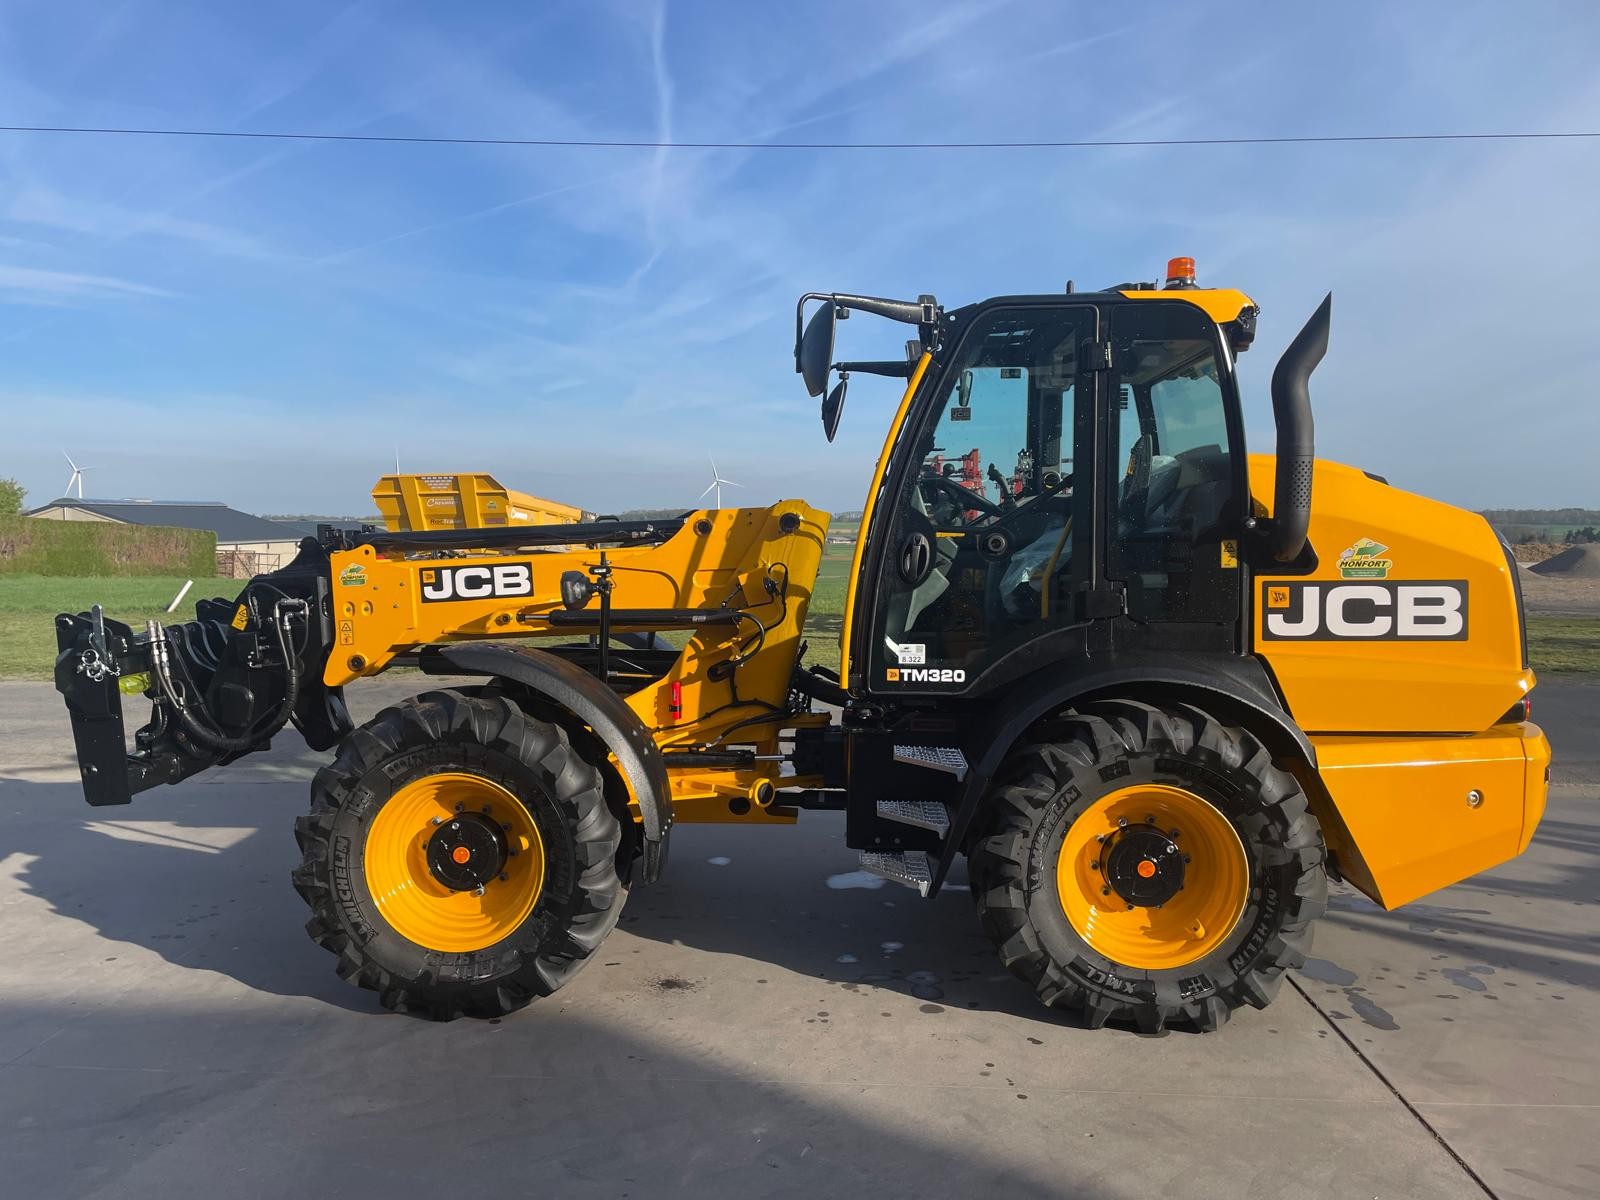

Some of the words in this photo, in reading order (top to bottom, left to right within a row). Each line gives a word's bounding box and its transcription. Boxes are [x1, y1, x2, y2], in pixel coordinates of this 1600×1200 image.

[1340, 560, 1388, 568] MONFORT
[424, 565, 531, 600] JCB
[1268, 585, 1464, 637] JCB
[900, 669, 966, 682] TM320
[334, 837, 365, 924] MICHELIN
[1231, 888, 1279, 970] MICHELIN
[1087, 965, 1137, 994] XMCL
